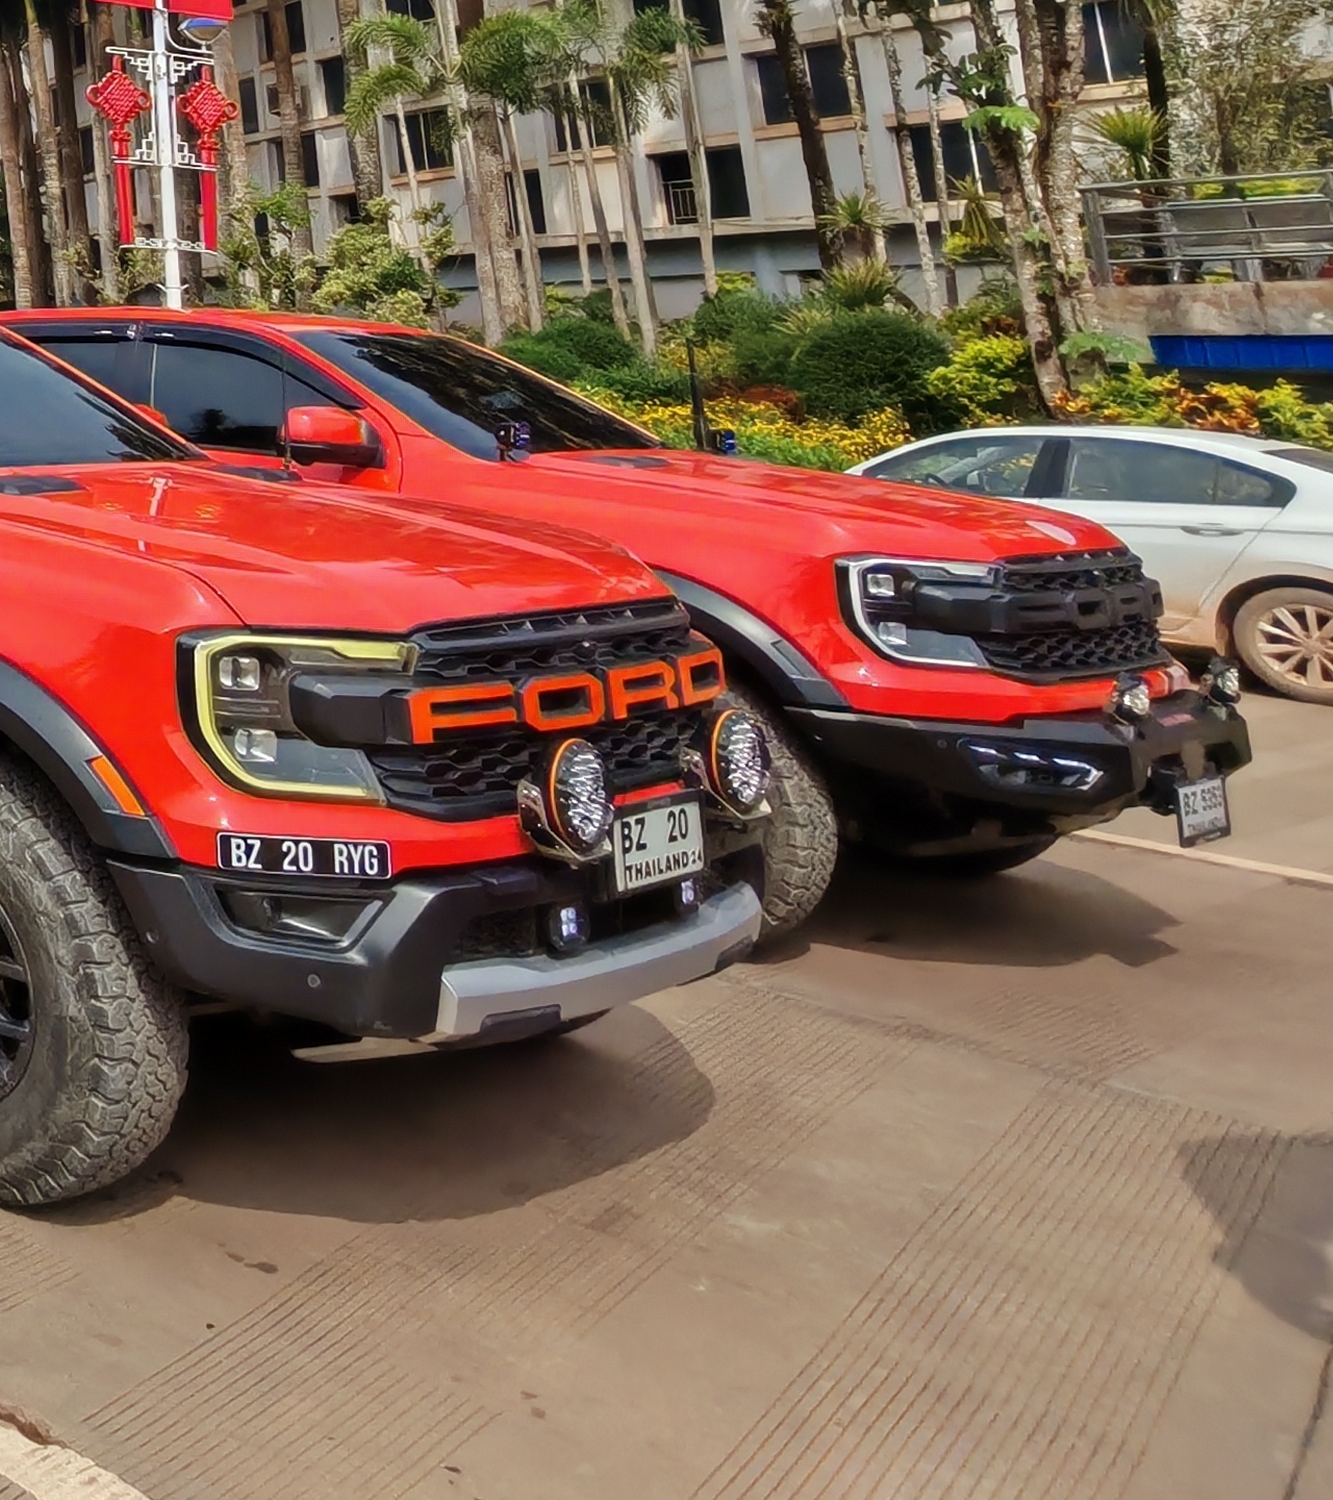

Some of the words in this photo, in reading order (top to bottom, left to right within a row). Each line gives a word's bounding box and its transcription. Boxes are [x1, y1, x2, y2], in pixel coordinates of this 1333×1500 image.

[408, 649, 726, 744] FORD
[621, 817, 648, 856] BZ
[667, 807, 689, 843] 20
[230, 838, 263, 869] BZ
[282, 841, 313, 872] 20
[333, 843, 379, 875] RYG
[625, 850, 690, 883] THAILAND
